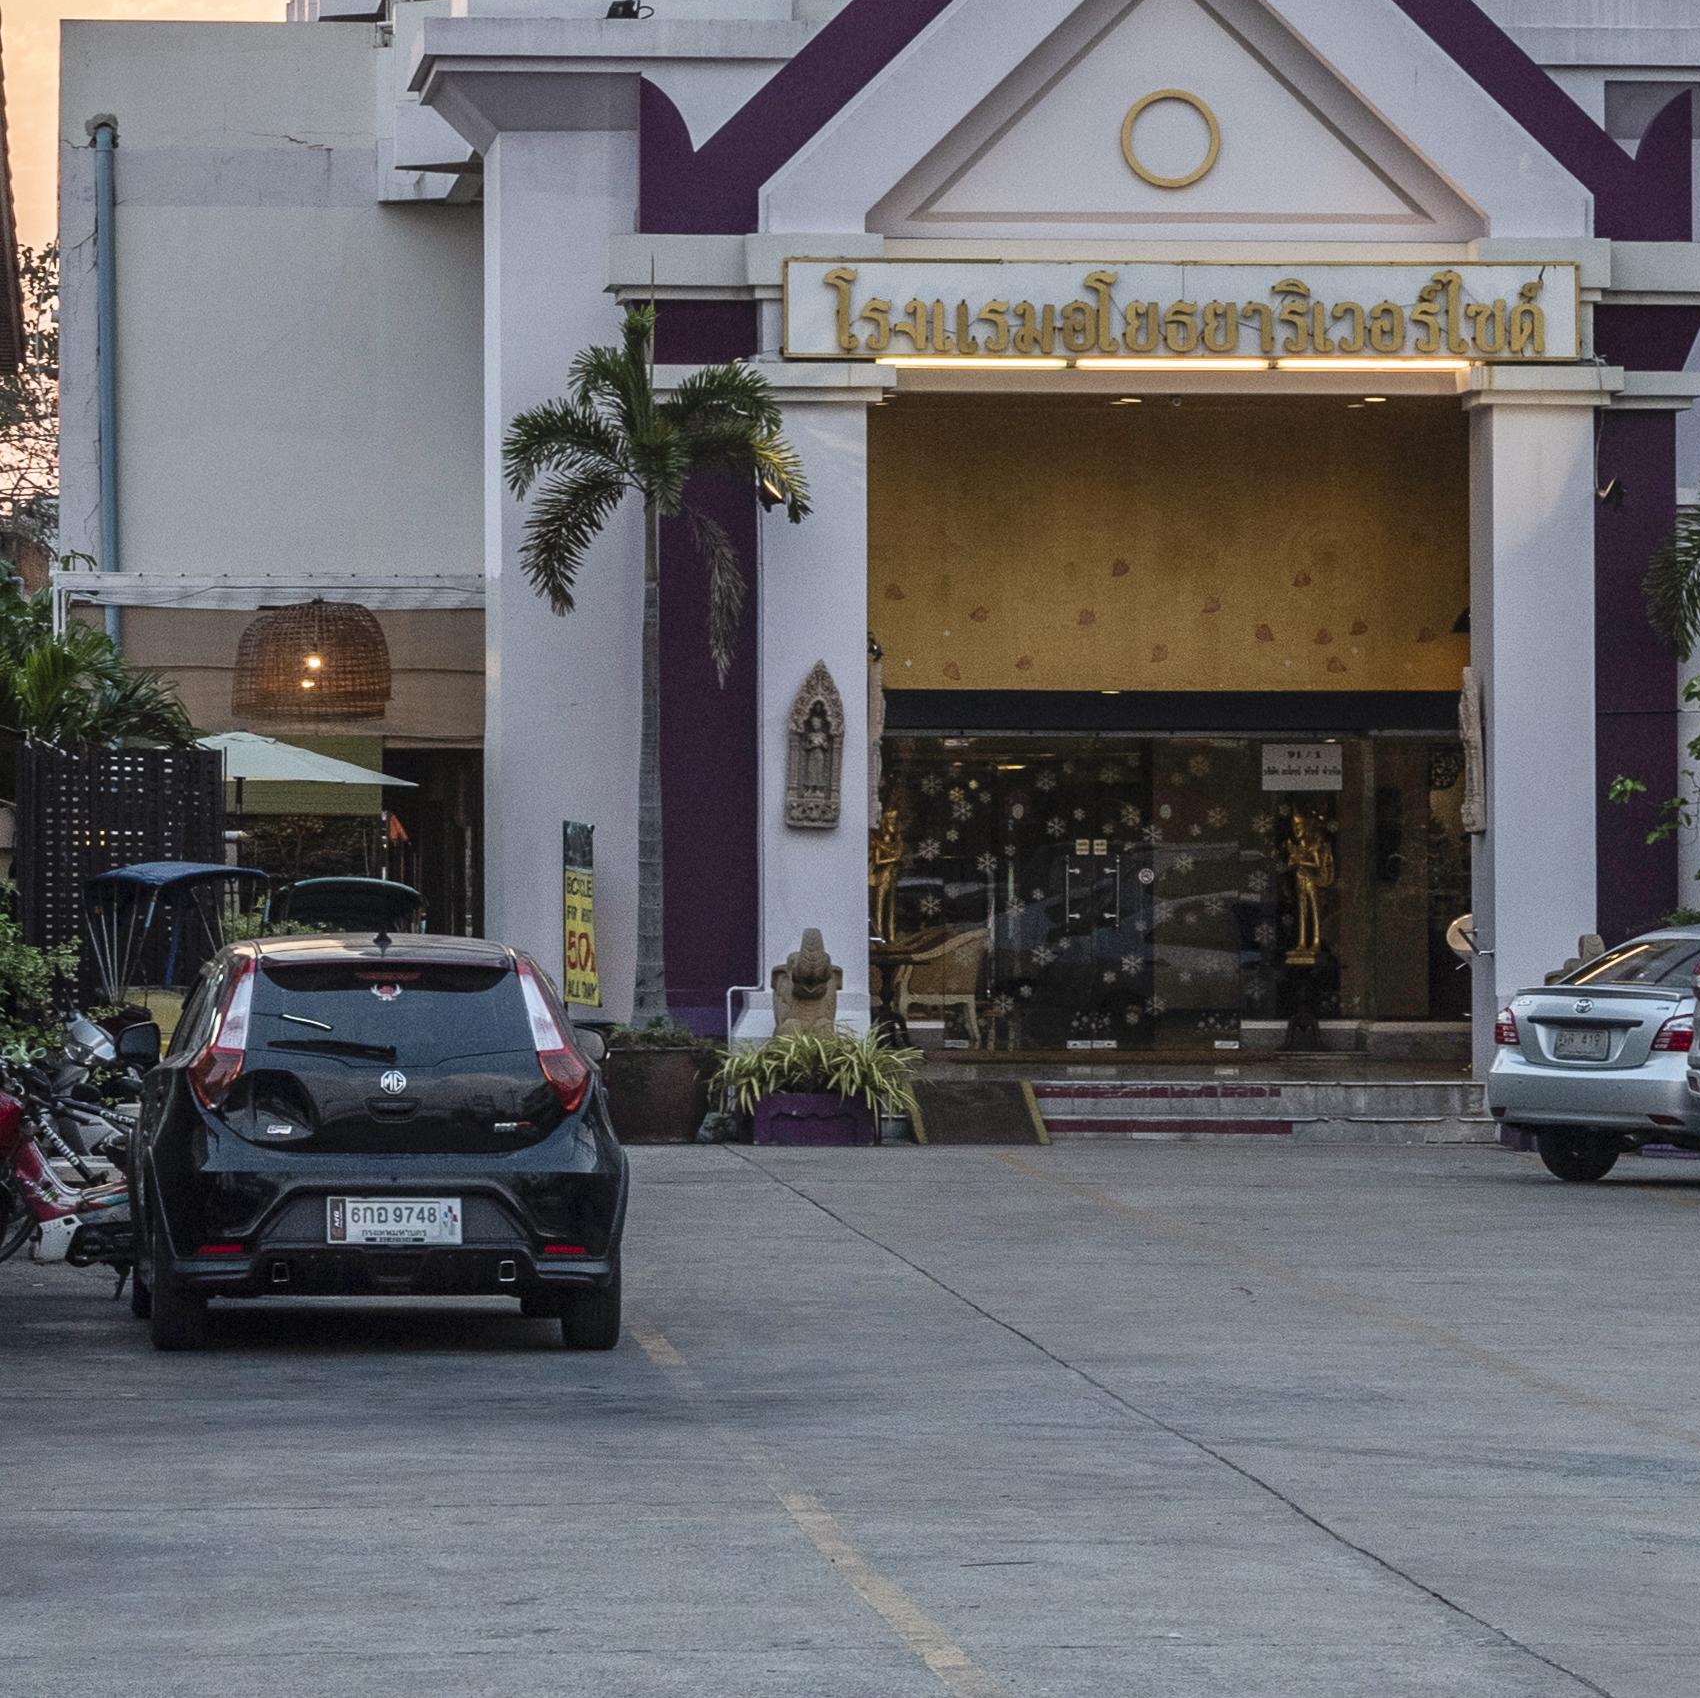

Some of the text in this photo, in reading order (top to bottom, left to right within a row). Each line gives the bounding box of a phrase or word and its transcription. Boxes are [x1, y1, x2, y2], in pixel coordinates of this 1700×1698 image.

[823, 267, 1546, 355] โรงแรมอโยธยาริเวอร์ไซด์
[382, 1072, 405, 1092] MG
[351, 1206, 388, 1224] 6กอ
[393, 1206, 437, 1224] 9748
